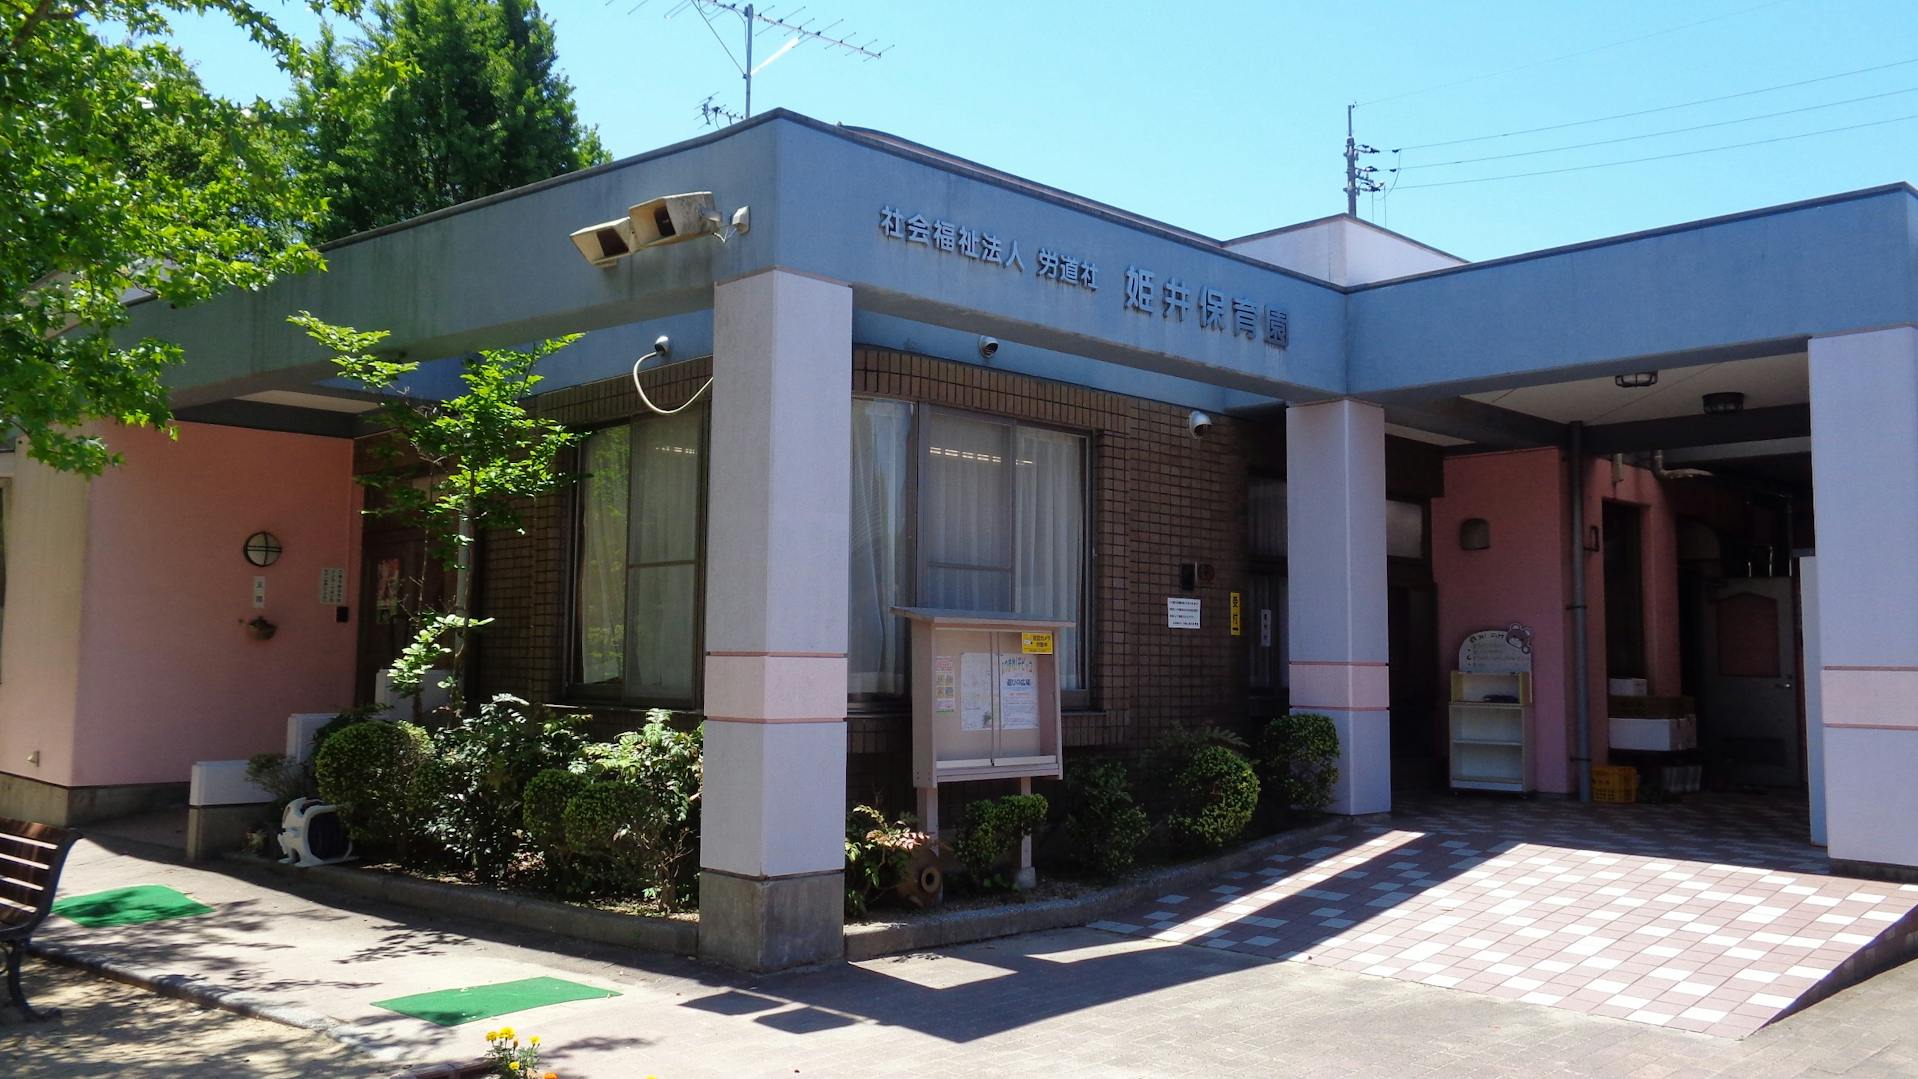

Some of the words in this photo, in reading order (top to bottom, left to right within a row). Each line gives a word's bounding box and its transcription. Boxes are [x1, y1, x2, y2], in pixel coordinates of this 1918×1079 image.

[880, 205, 1024, 272] 社会福祉法人
[1036, 247, 1098, 290] 労道社
[1124, 263, 1288, 349] 姫井保育園
